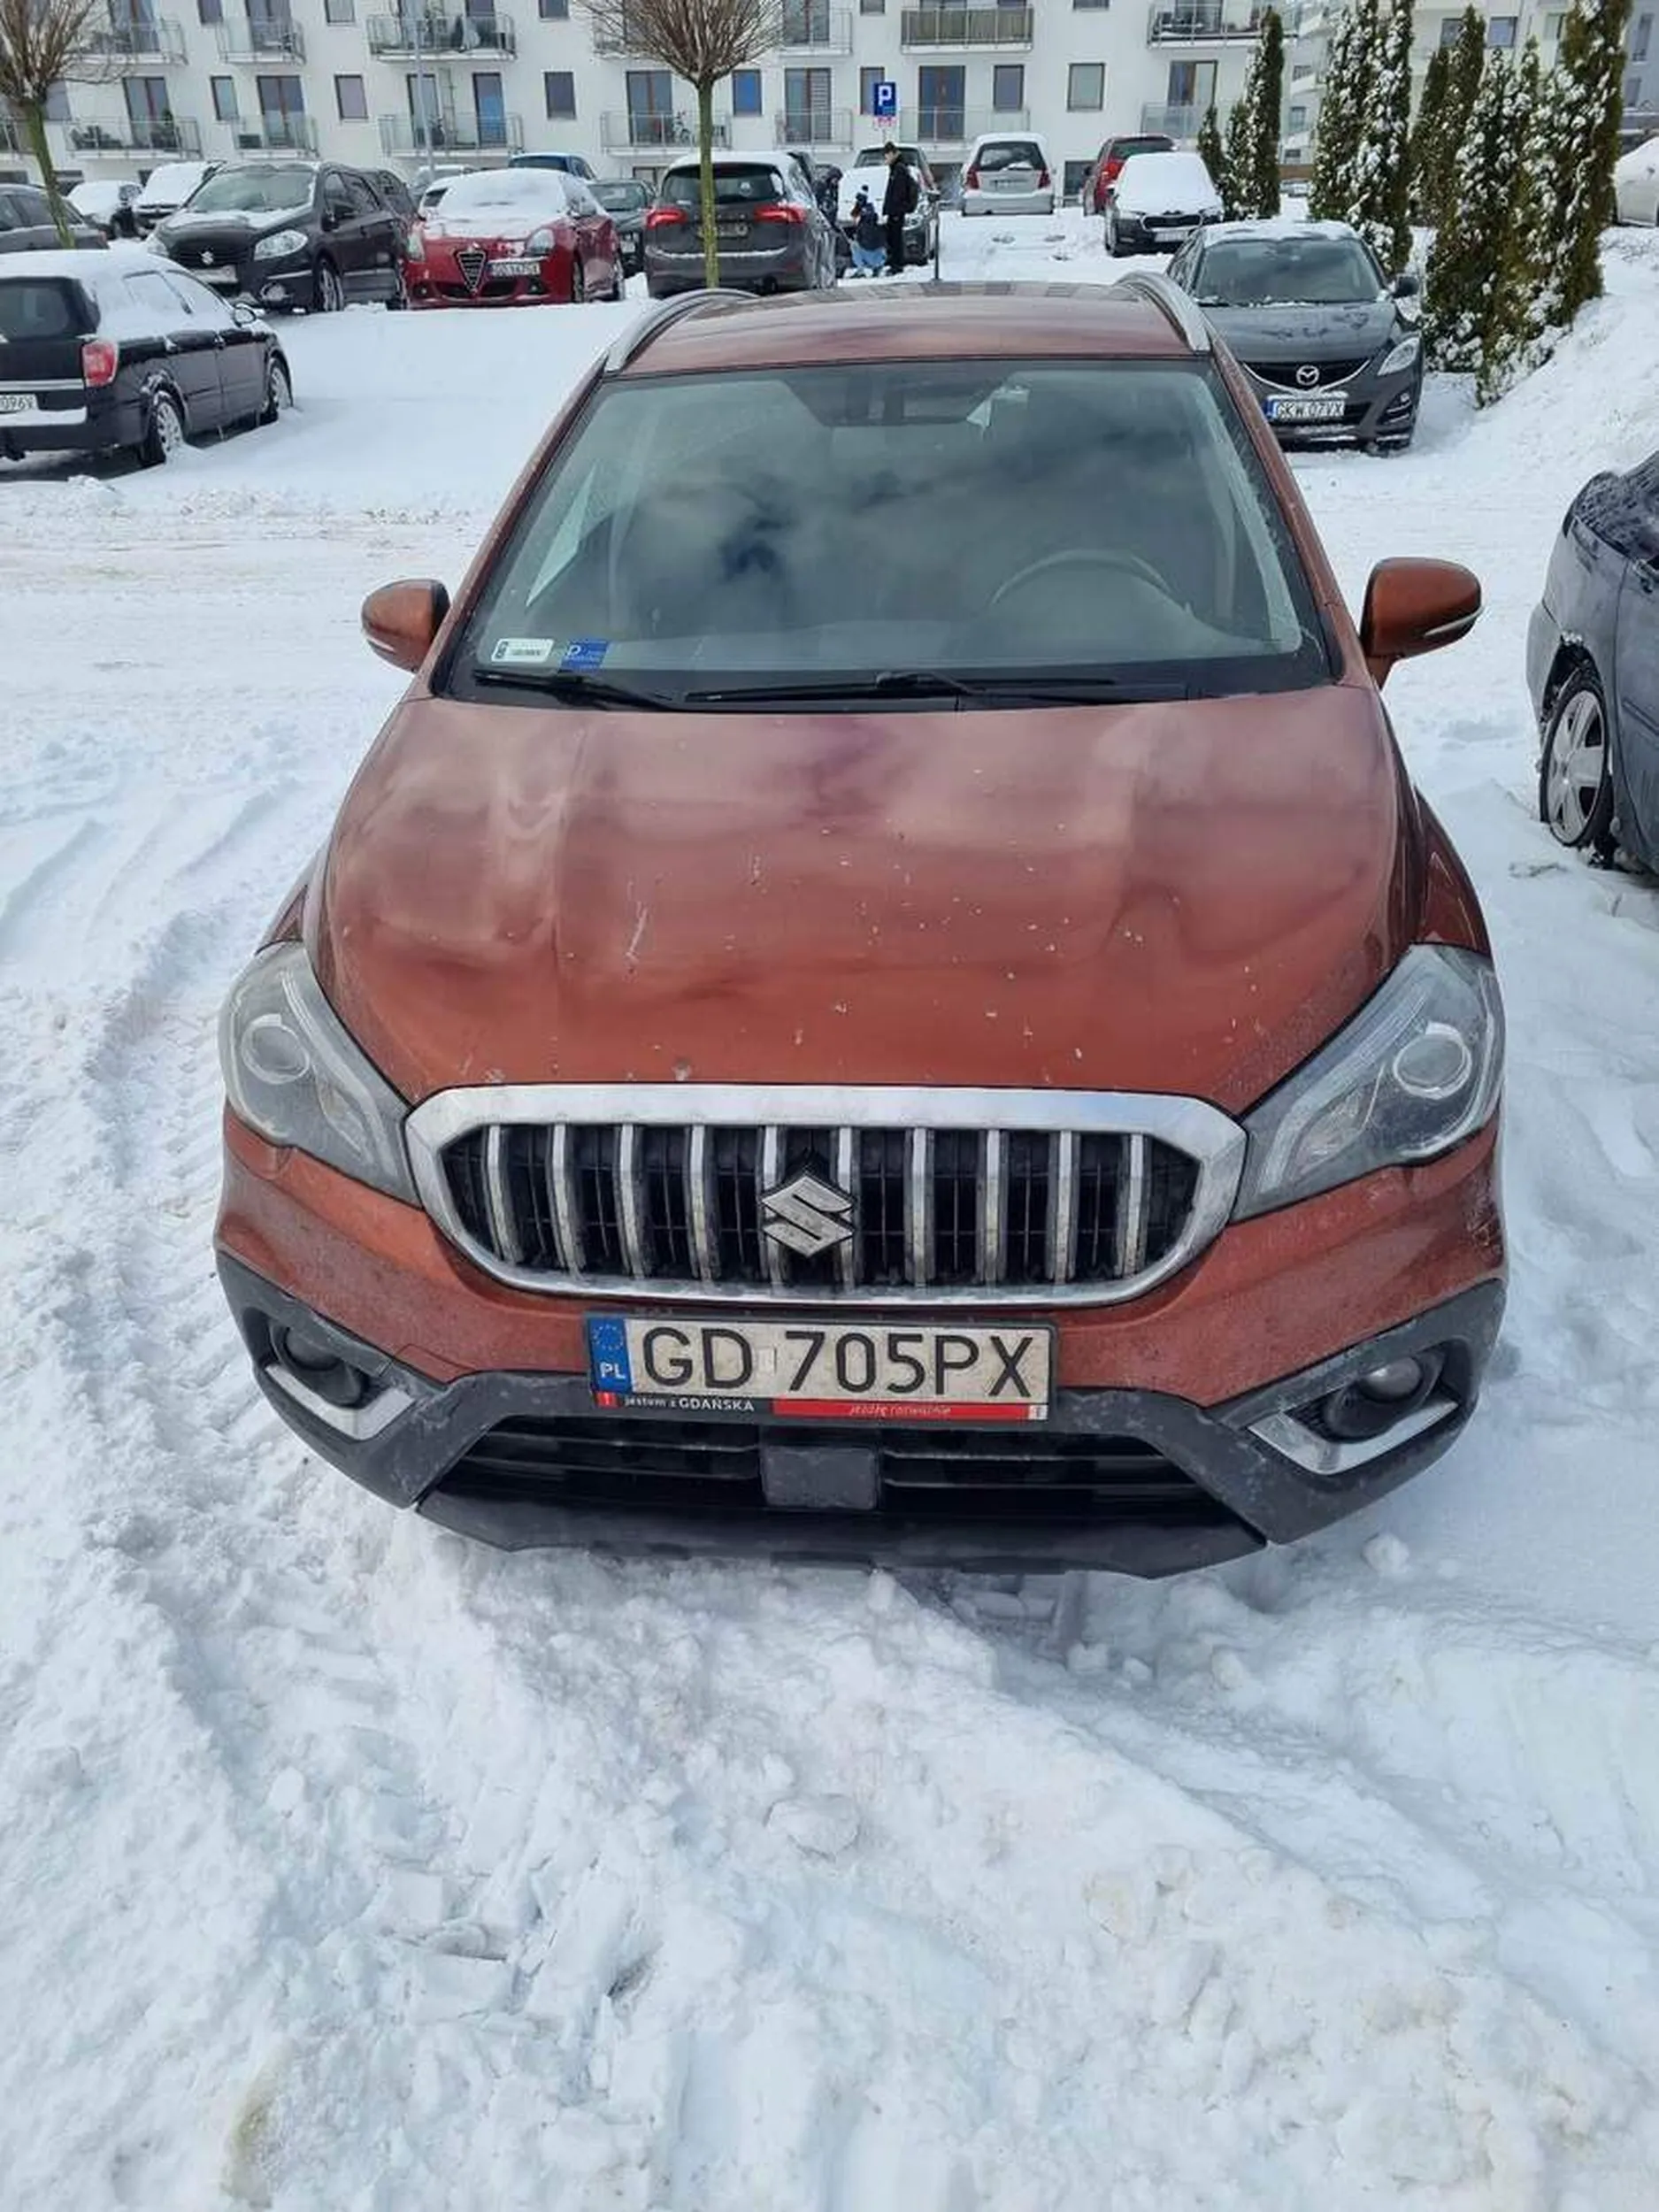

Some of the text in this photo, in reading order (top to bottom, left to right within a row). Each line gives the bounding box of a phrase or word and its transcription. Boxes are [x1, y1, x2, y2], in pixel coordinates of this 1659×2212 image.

[878, 85, 892, 106] P
[599, 1361, 626, 1379] PL
[642, 1326, 1033, 1398] GD 705PX
